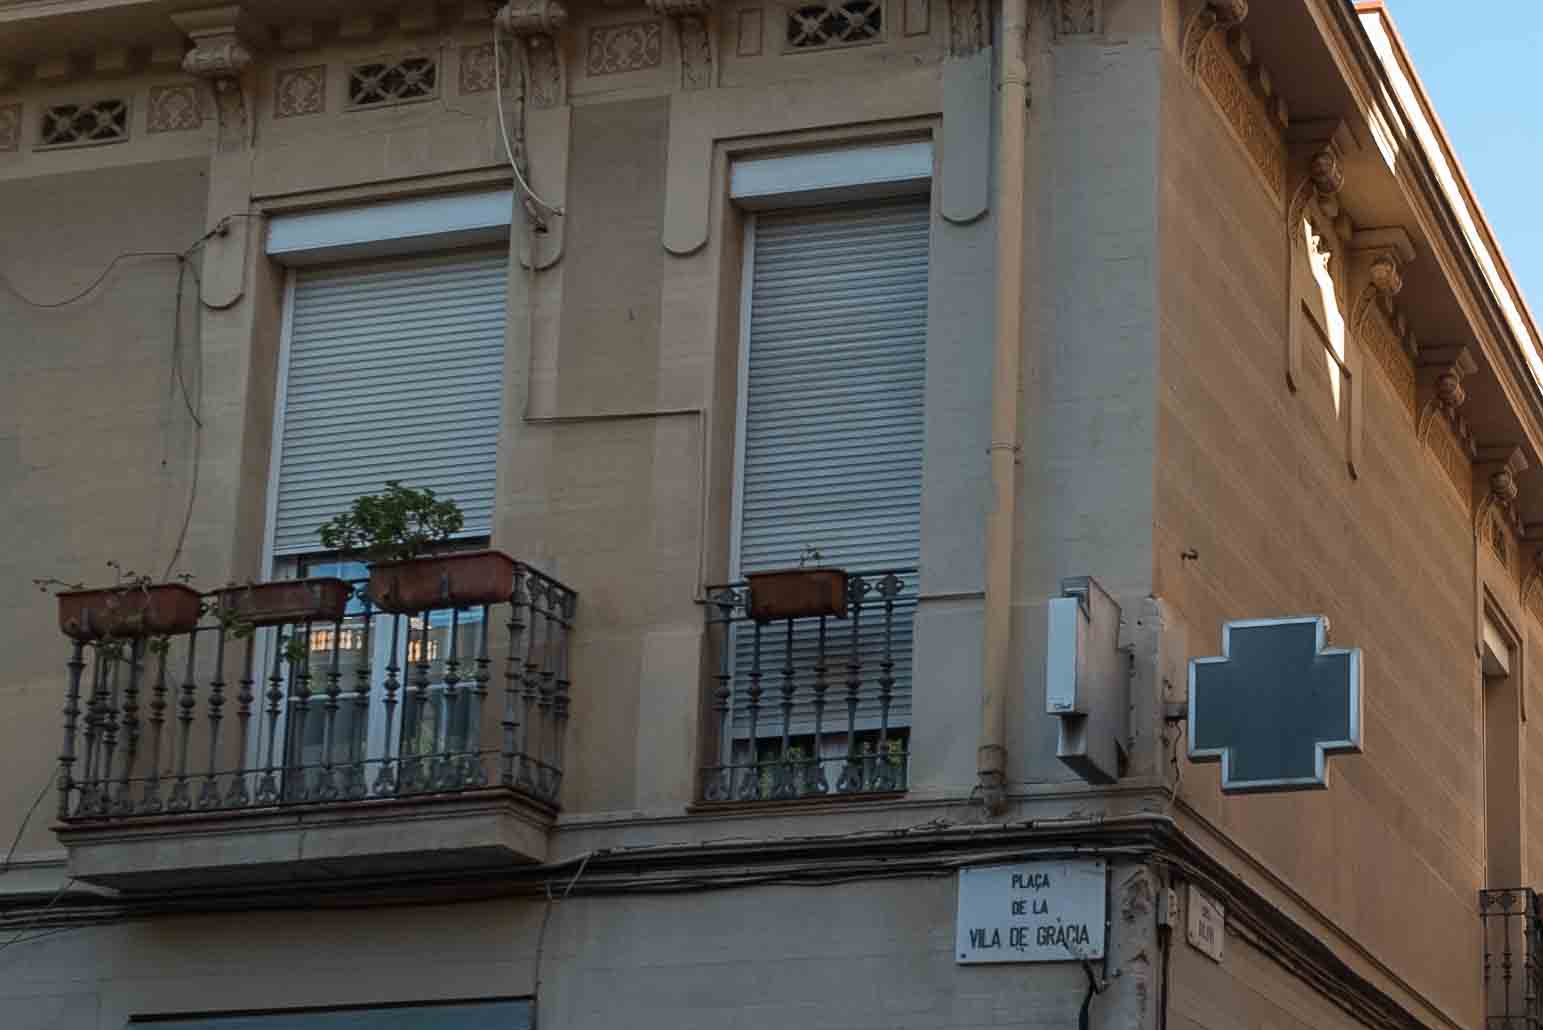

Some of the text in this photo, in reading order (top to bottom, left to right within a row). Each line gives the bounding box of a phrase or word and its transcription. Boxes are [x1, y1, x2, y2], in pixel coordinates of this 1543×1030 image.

[1011, 872, 1050, 892] PLAÇA
[1011, 899, 1049, 916] DE LA
[969, 917, 1090, 949] VILA DE GRÀCIA
